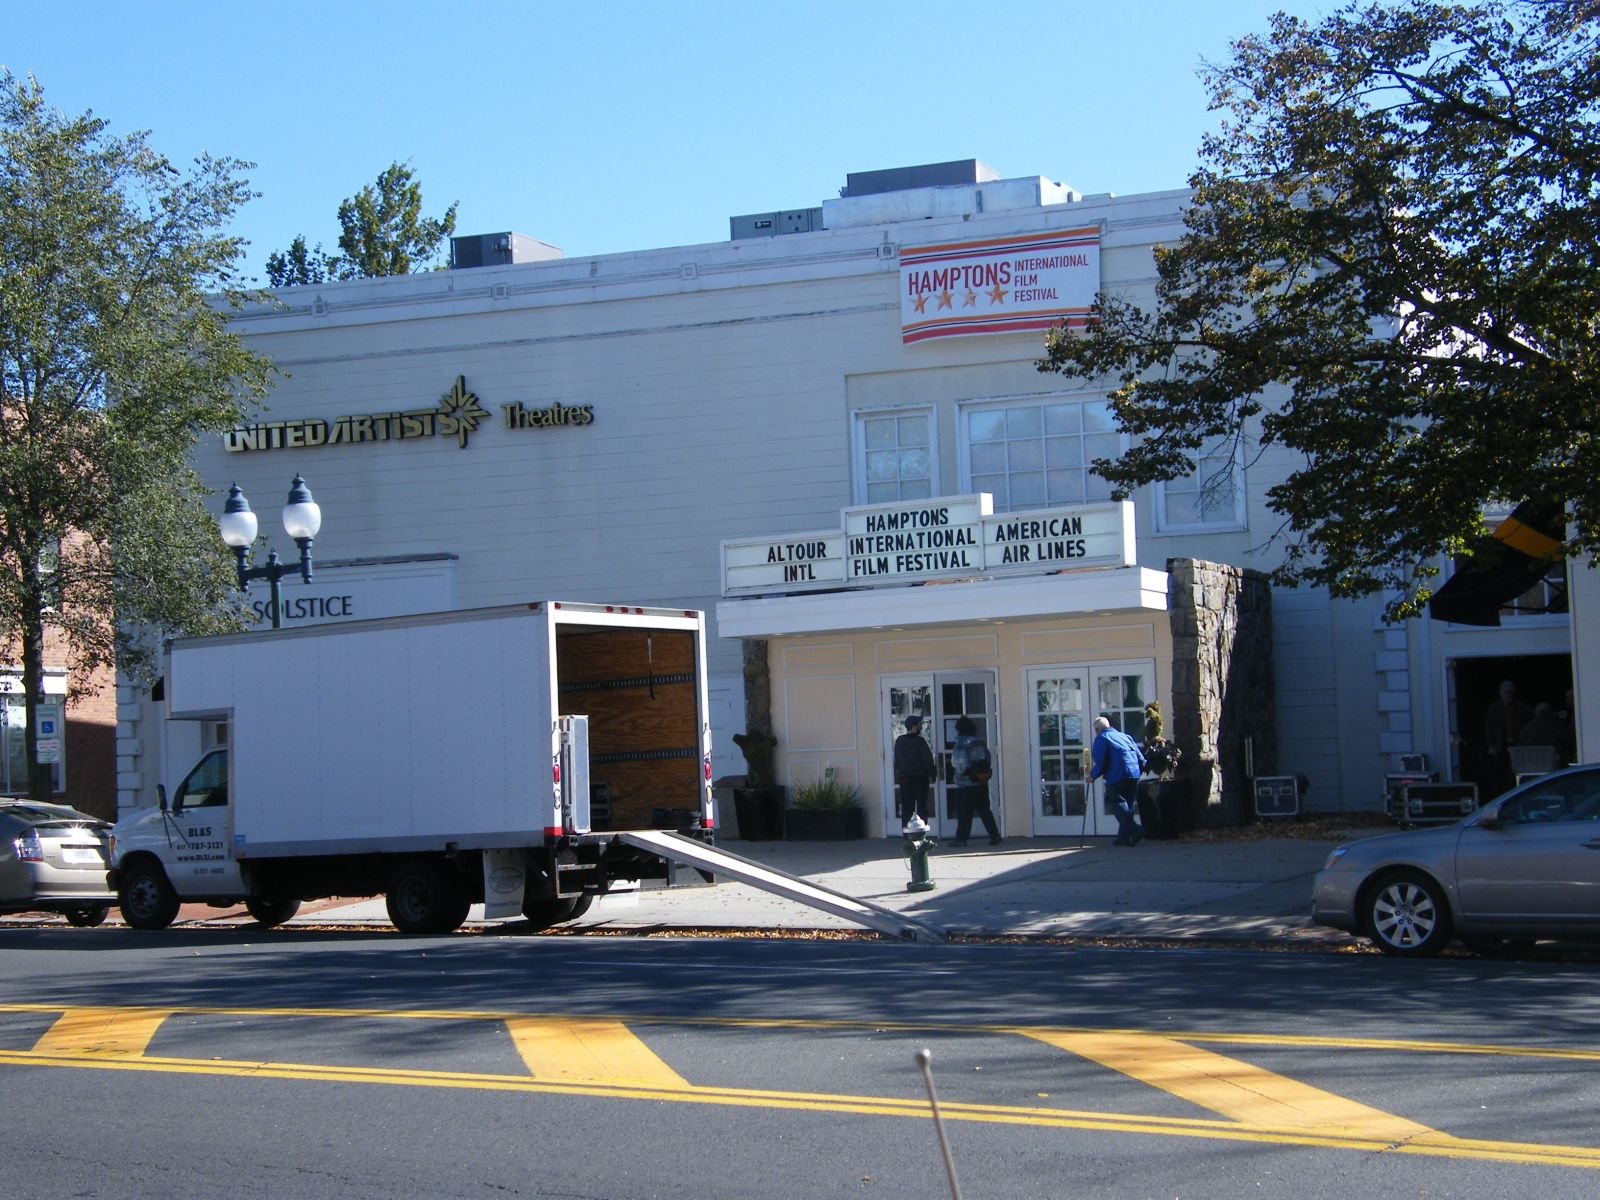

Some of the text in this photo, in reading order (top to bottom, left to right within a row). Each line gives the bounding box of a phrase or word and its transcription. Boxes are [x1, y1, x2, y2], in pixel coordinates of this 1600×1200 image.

[1014, 253, 1089, 272] INTERNATIONAL
[907, 261, 1011, 296] HAMPTONS
[1014, 274, 1038, 287] FILM
[1014, 288, 1059, 303] FESTIVAL
[223, 418, 329, 452] UNITED
[501, 400, 594, 428] Theatres
[866, 508, 948, 533] HAMPTONS
[995, 516, 1082, 543] AMERICAN
[767, 541, 827, 563] ALTOUR
[849, 527, 977, 556] INTERNATIONAL
[1002, 539, 1086, 564] AIR LINES
[784, 563, 816, 582] INTL
[853, 550, 971, 576] FILM FESTIVAL
[252, 595, 353, 621] SOLSTICE
